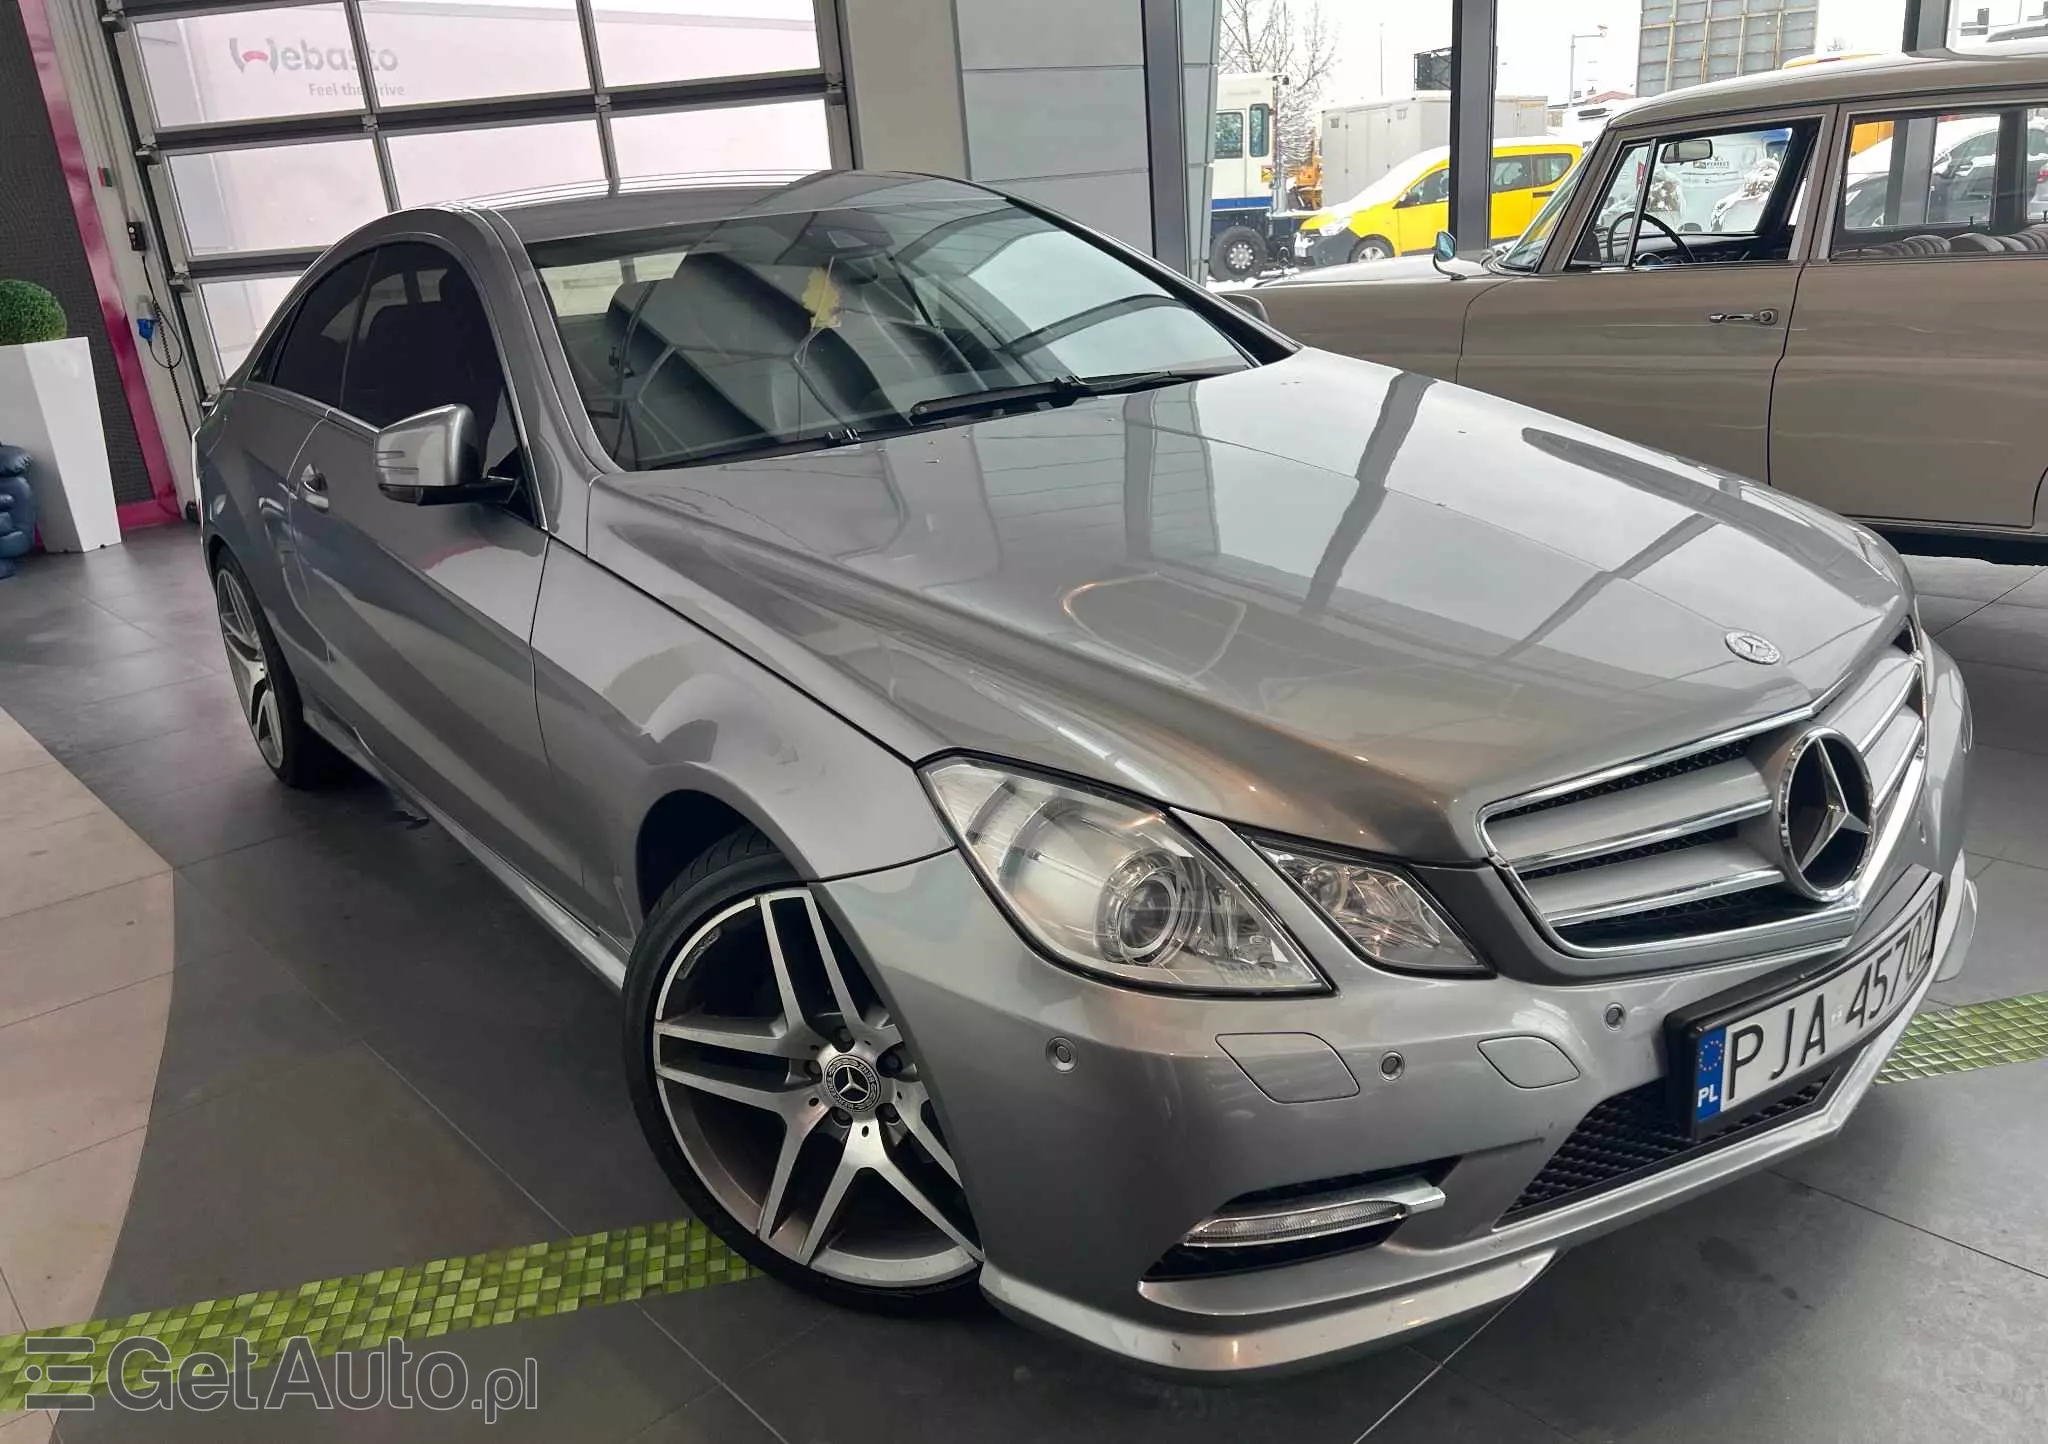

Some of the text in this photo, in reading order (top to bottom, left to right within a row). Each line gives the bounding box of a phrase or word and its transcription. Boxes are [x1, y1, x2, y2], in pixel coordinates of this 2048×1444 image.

[308, 83, 338, 96] Feel
[379, 82, 405, 95] rive
[1728, 898, 1934, 1100] PJA 45702
[1697, 1084, 1719, 1107] PL
